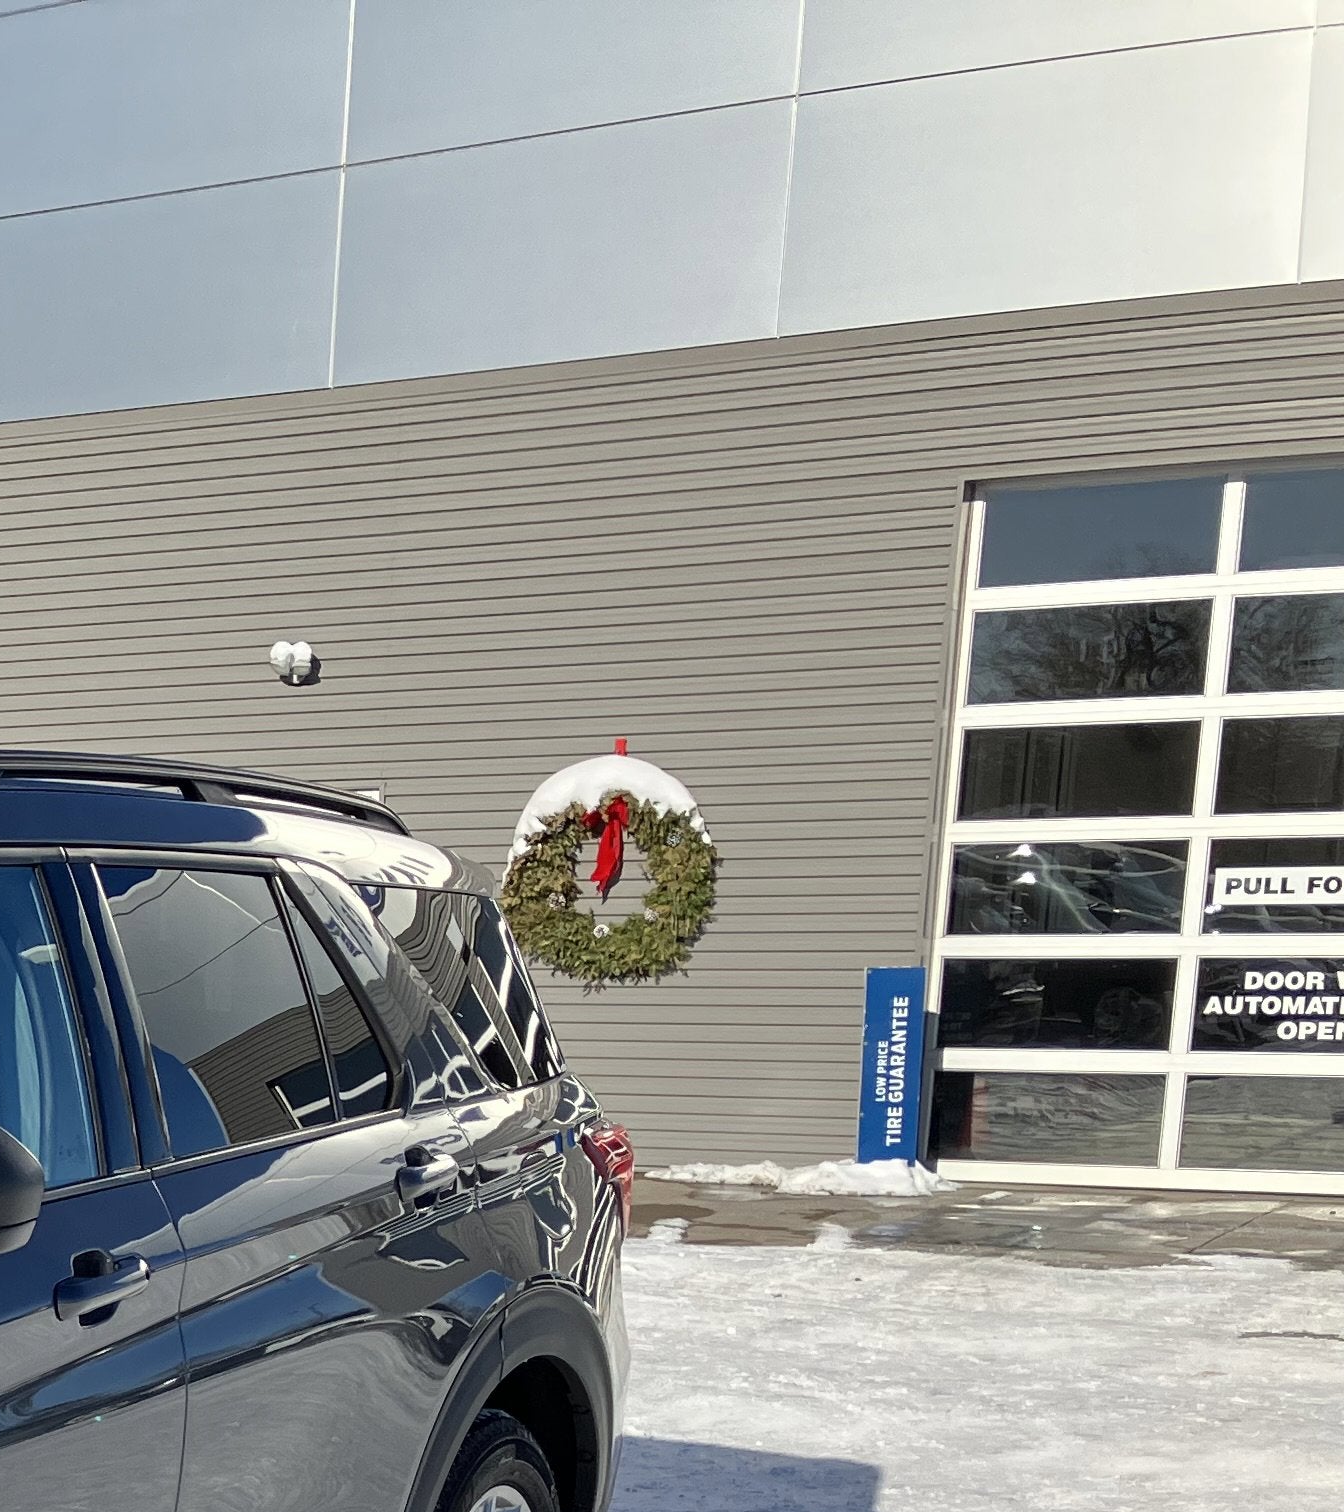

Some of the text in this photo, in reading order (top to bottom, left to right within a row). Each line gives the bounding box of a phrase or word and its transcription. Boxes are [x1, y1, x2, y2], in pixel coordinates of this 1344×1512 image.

[1225, 877, 1295, 895] PULL
[1244, 971, 1325, 990] DOOR
[875, 1040, 889, 1102] LOW PRICE
[886, 996, 909, 1147] TIRE GUARANTEE
